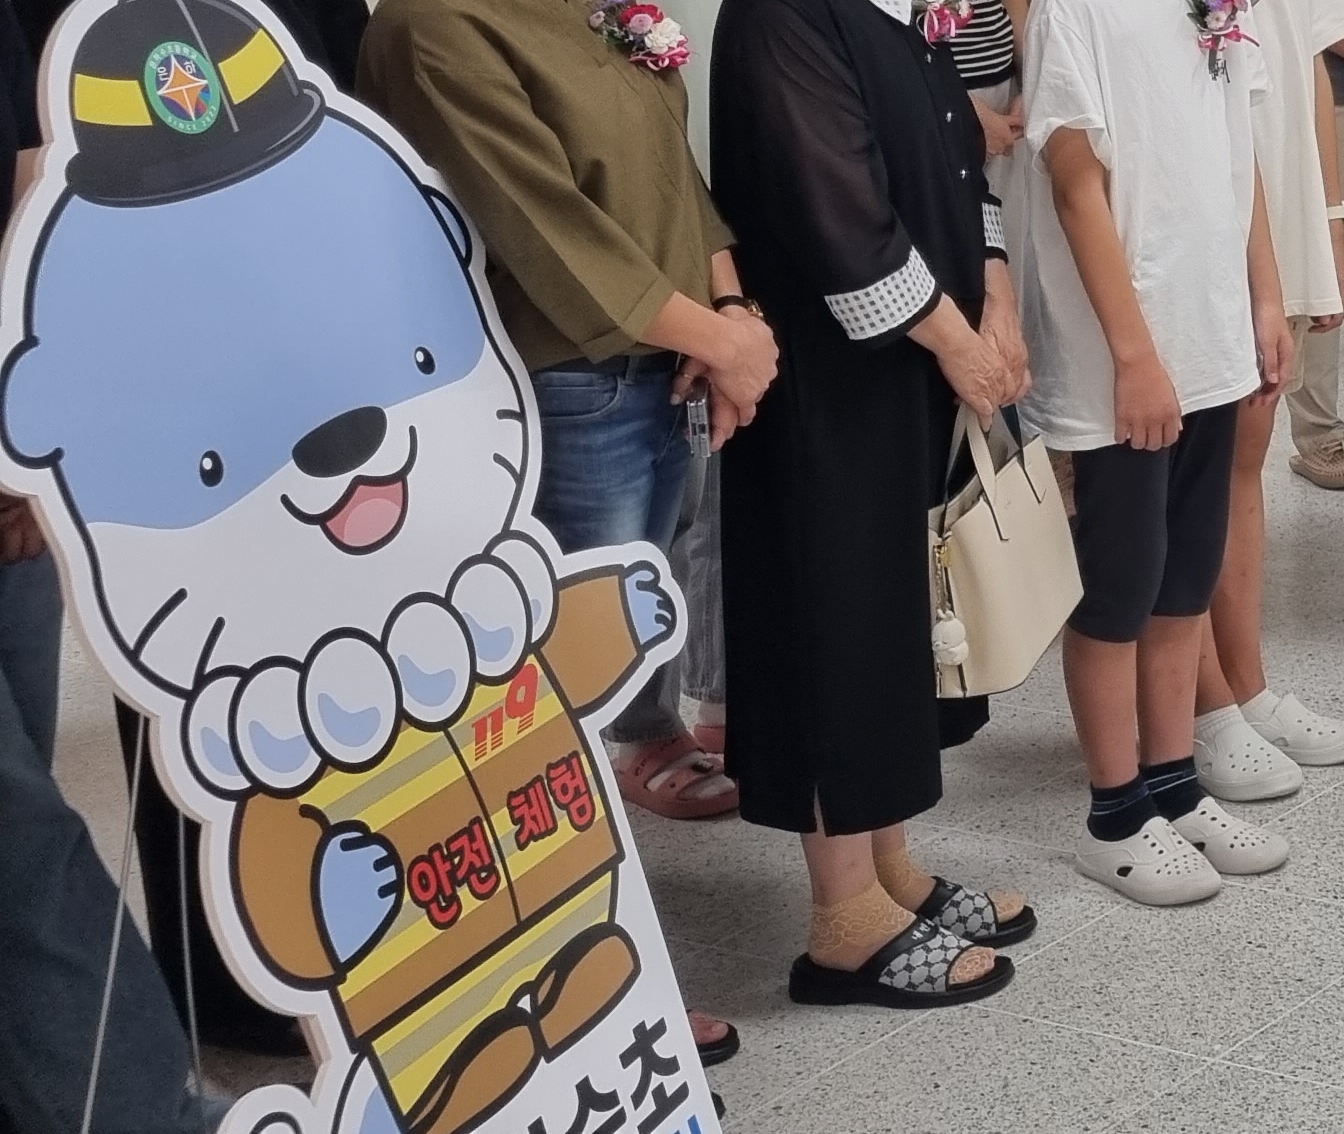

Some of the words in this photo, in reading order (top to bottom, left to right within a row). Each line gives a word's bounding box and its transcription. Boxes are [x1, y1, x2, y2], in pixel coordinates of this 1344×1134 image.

[471, 663, 538, 762] 119
[407, 818, 499, 927] 안전
[508, 753, 594, 845] 체험
